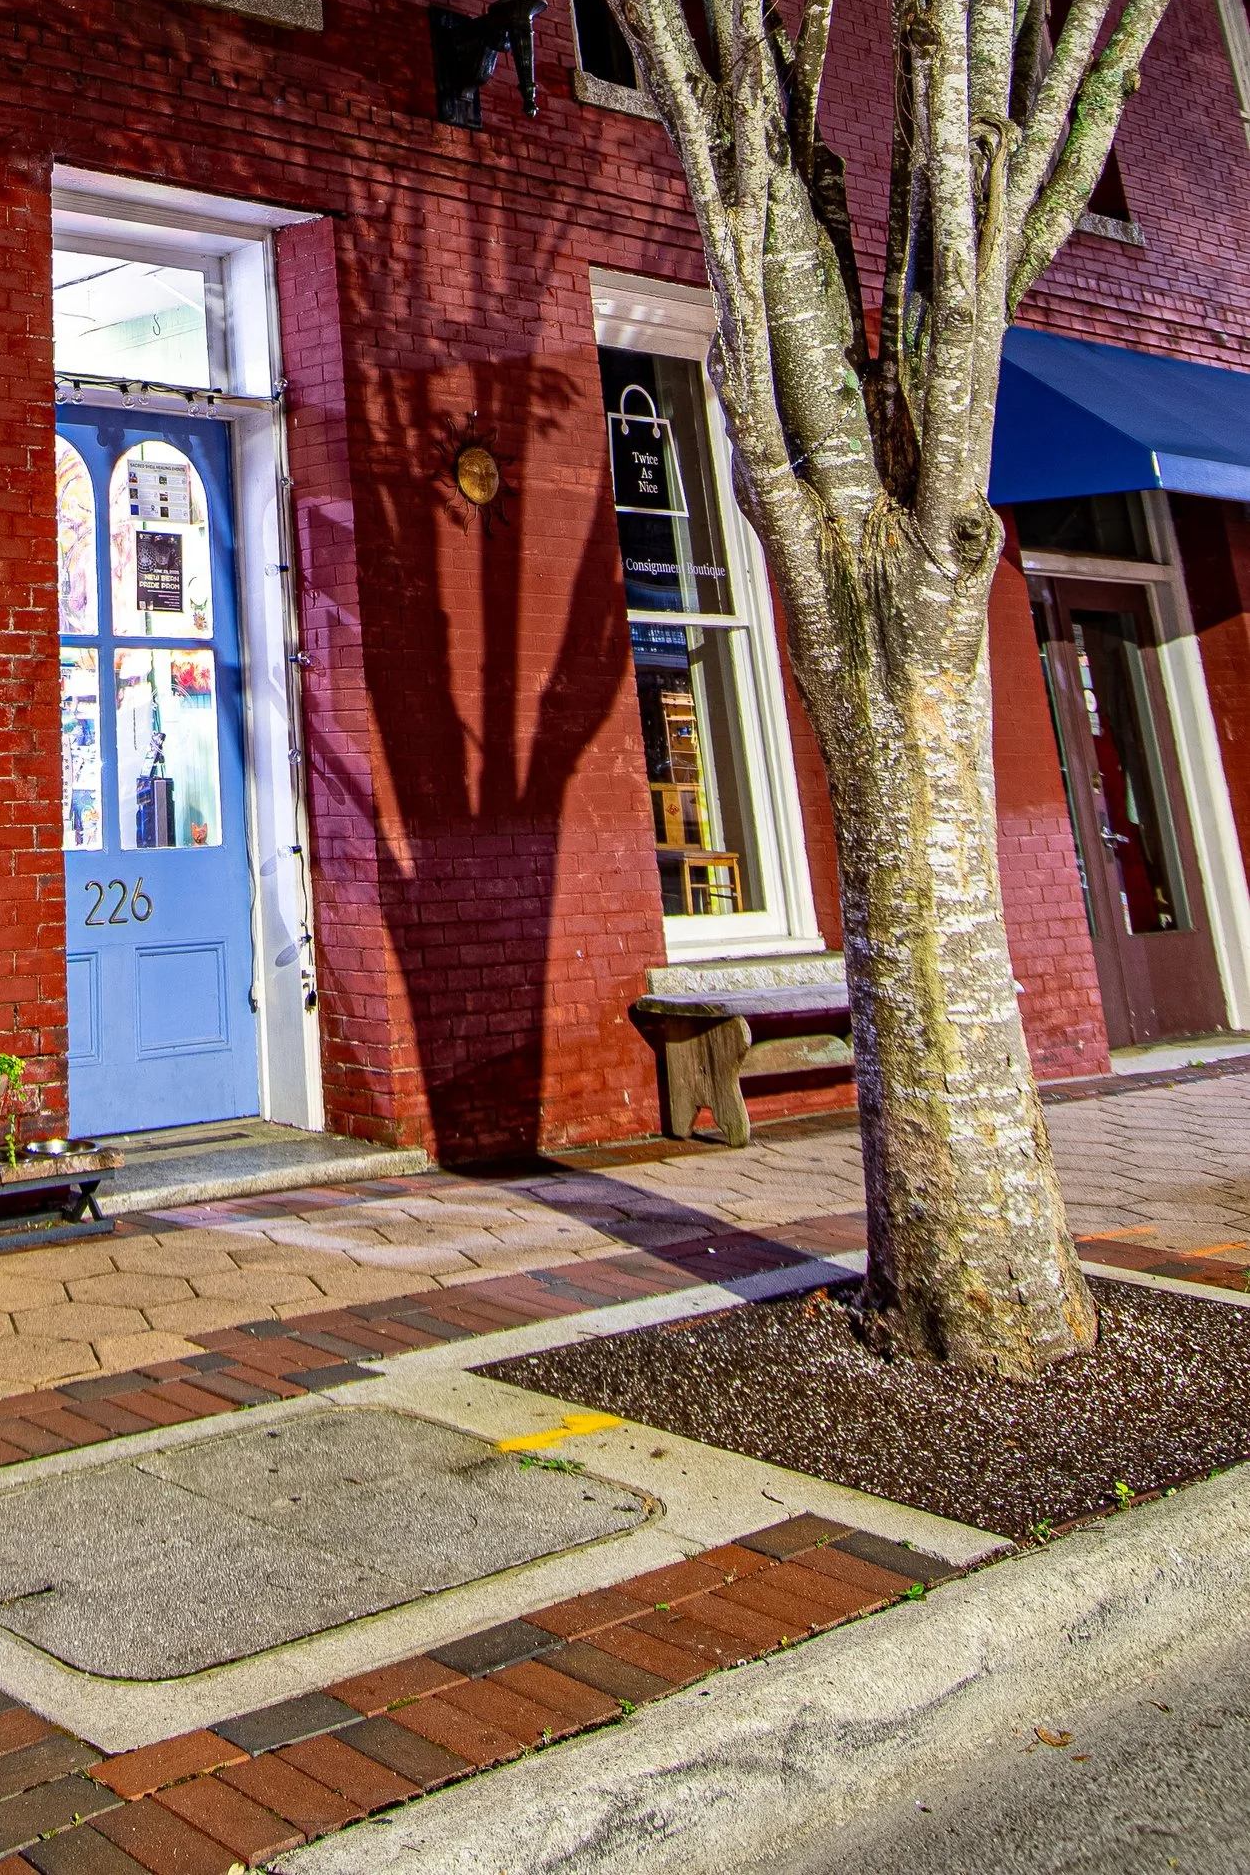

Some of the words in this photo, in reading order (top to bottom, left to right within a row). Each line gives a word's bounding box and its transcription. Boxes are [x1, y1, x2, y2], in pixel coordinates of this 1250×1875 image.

[632, 451, 659, 465] Twice
[641, 467, 653, 479] As
[639, 481, 659, 494] Nice
[686, 562, 726, 579] Boutique
[144, 573, 160, 581] NEW
[161, 574, 180, 583] BERN
[139, 581, 160, 589] PRIDE
[161, 582, 180, 590] PROM
[85, 876, 153, 926] 226
